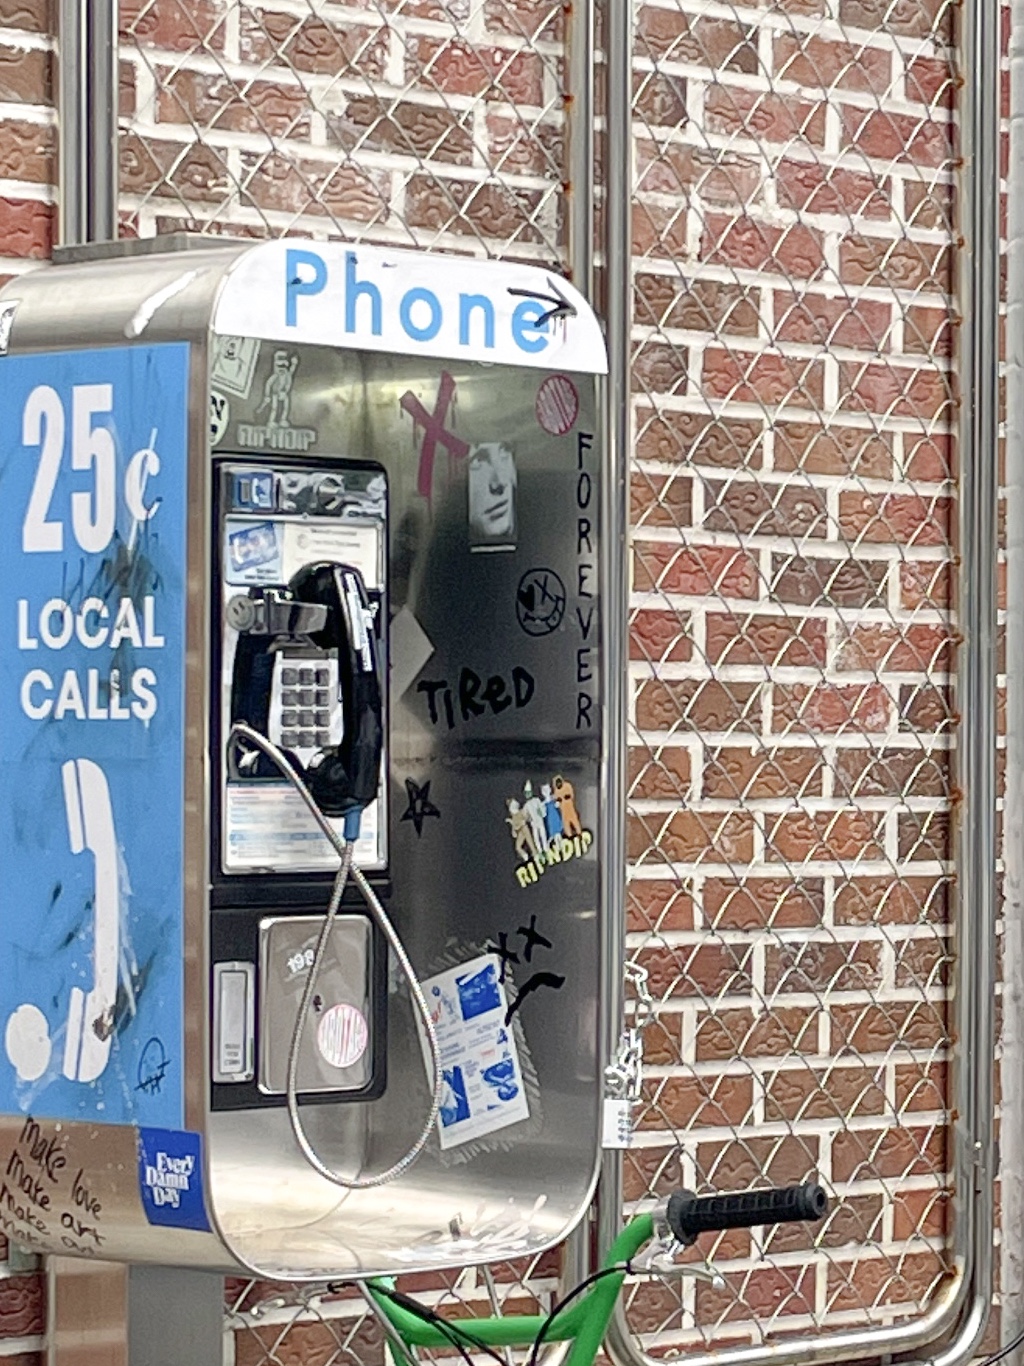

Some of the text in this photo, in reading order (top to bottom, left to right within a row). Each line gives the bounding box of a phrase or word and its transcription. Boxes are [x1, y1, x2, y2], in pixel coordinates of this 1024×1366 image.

[284, 249, 551, 354] Phone
[576, 431, 593, 730] FOREVER
[17, 596, 165, 650] LOCAL
[20, 668, 157, 720] CALLS
[145, 1166, 189, 1190] Damn
[156, 1152, 195, 1173] Every
[153, 1186, 180, 1208] Day
